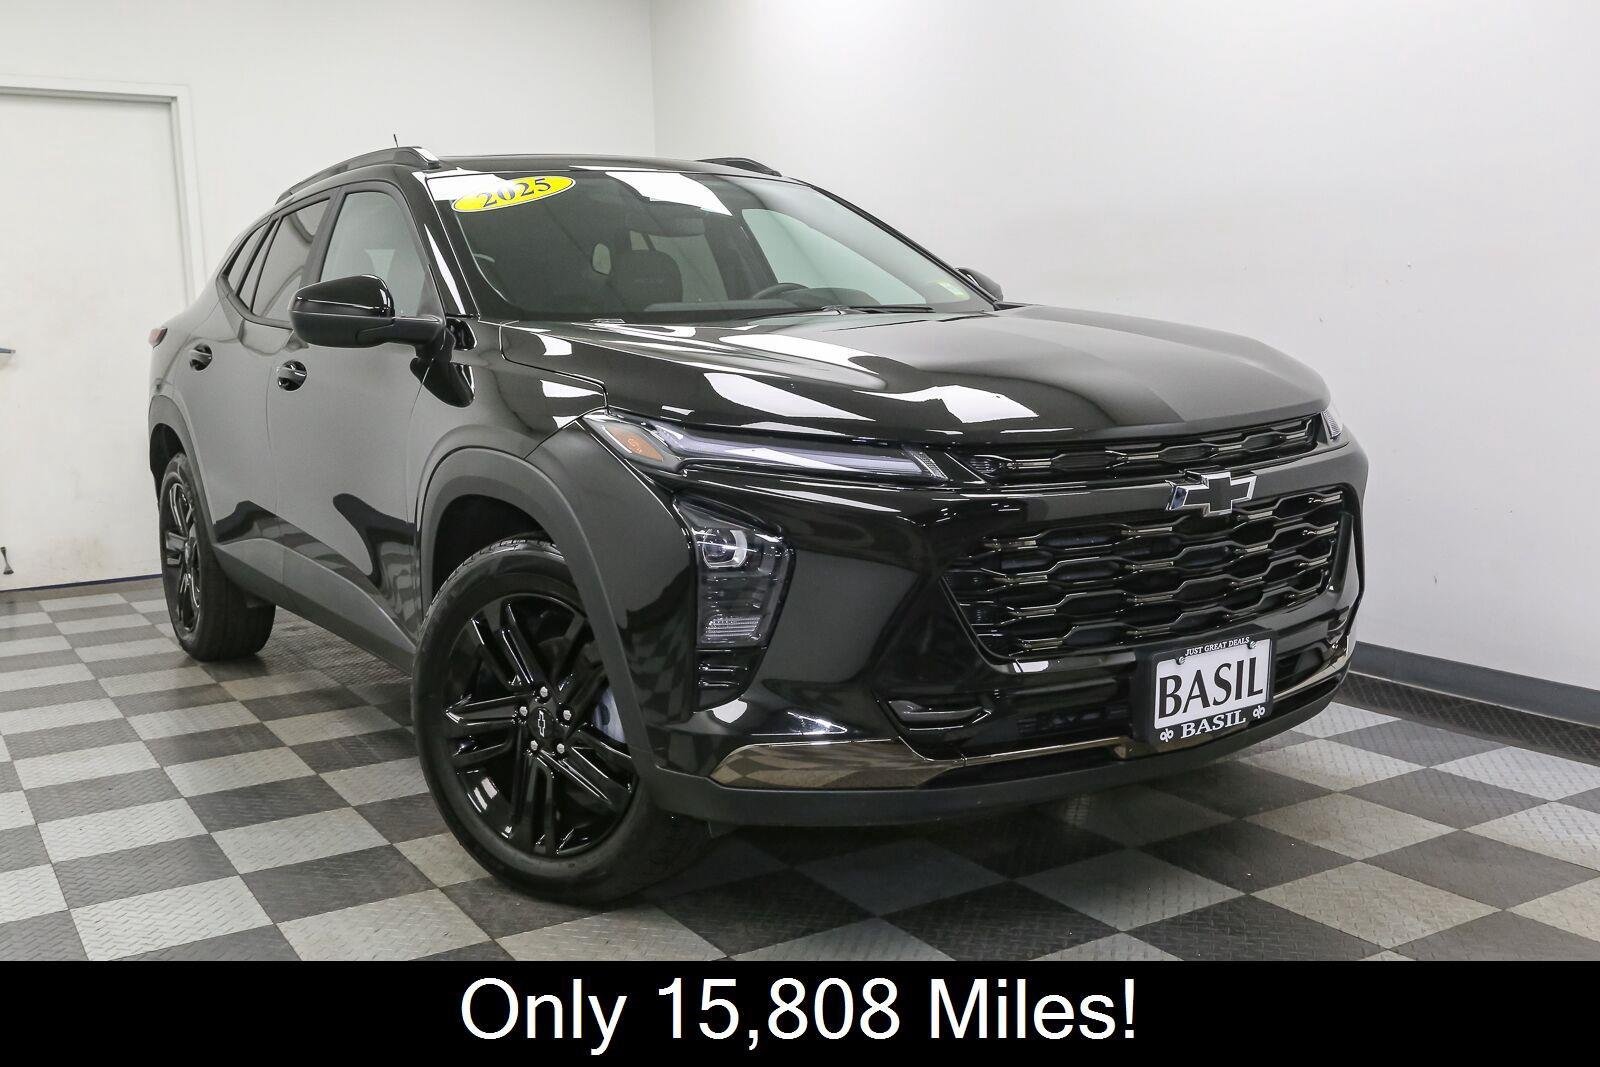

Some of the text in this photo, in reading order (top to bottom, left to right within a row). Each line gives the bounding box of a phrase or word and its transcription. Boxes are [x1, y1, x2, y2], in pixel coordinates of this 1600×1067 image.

[476, 177, 552, 208] 2025
[1185, 636, 1250, 656] JUST GREAT DEALS
[1158, 657, 1264, 719] BASIL
[1180, 710, 1246, 739] BASIL
